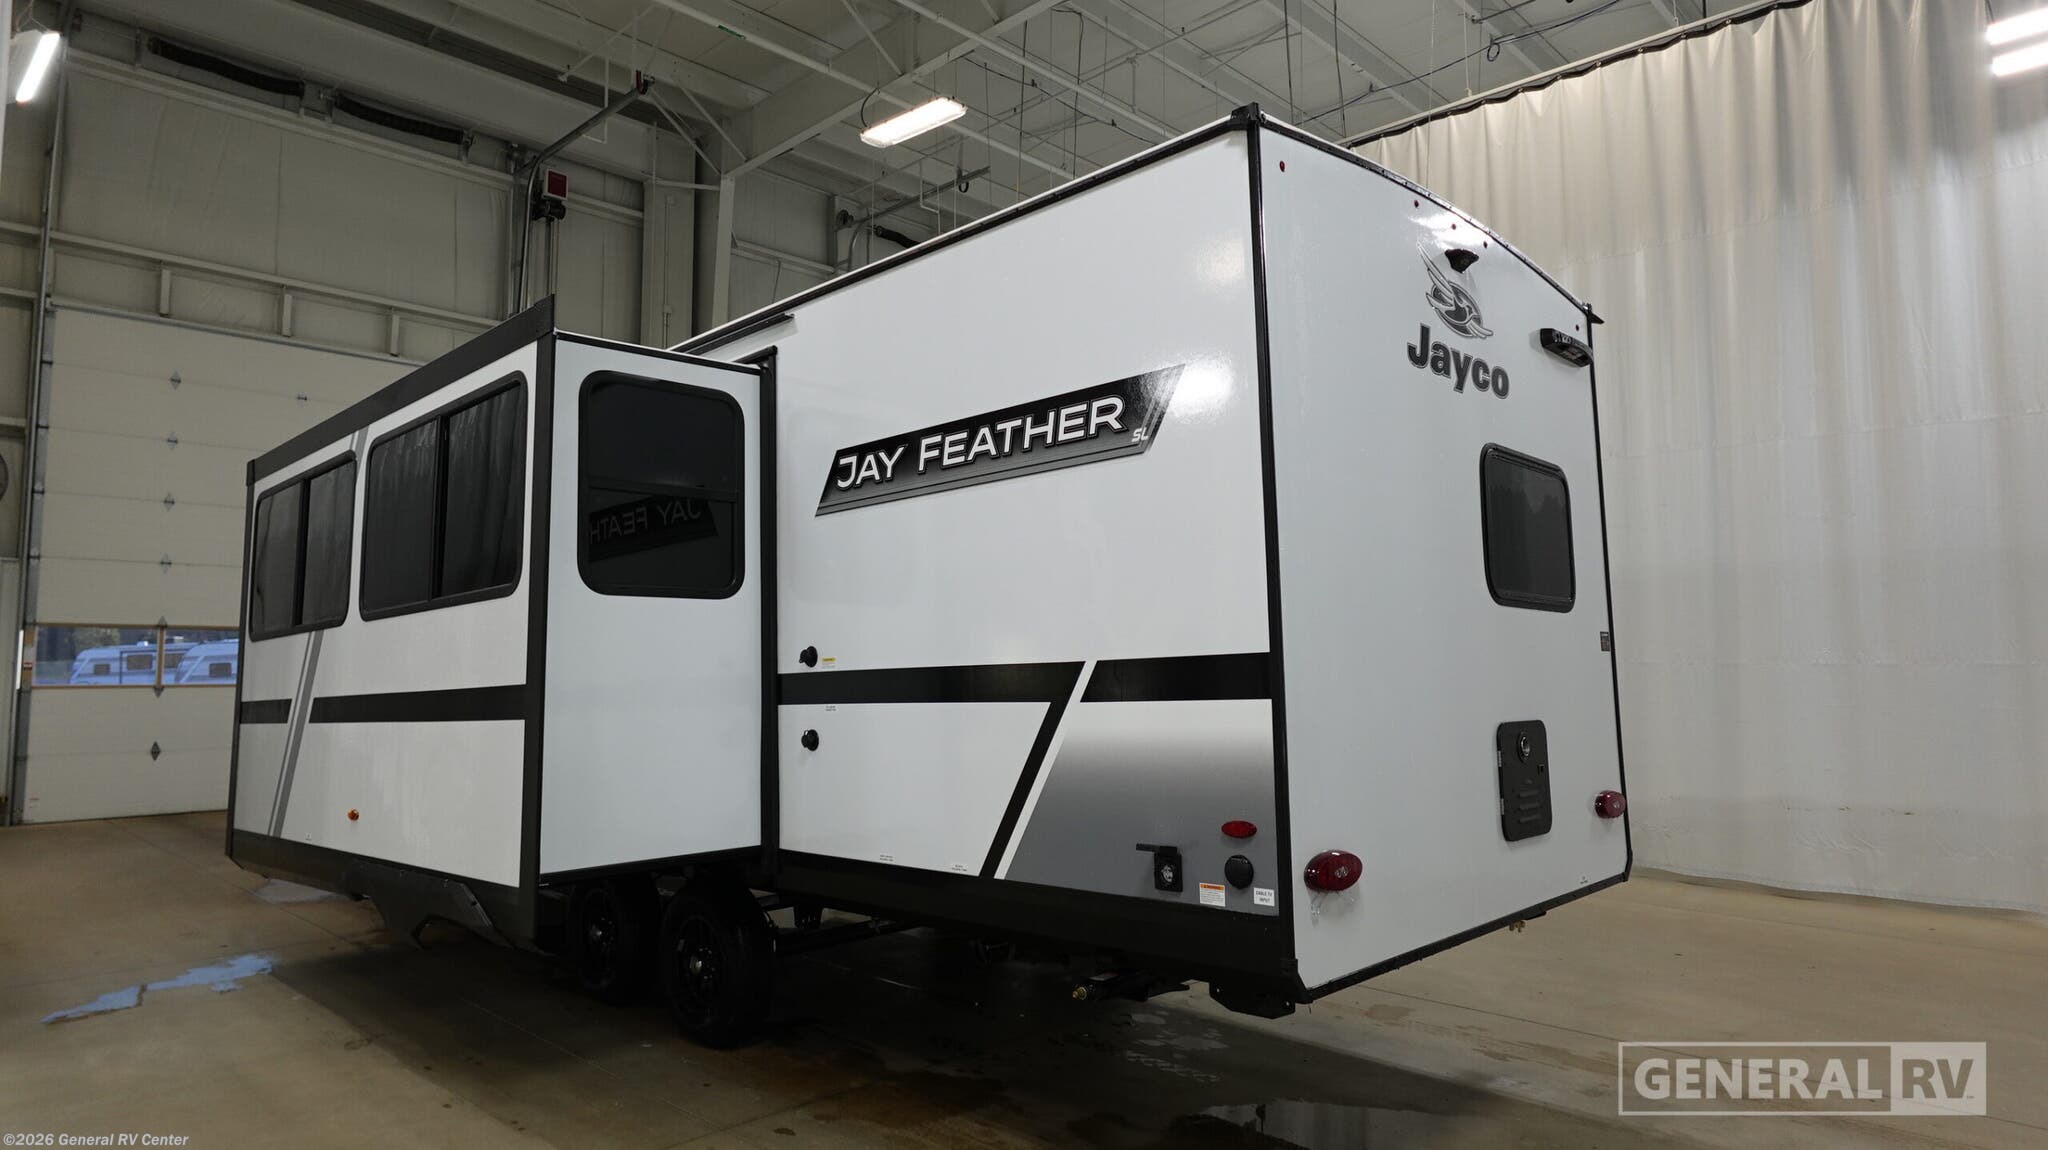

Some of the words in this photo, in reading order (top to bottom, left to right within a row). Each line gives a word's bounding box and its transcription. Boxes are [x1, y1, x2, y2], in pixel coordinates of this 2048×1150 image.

[1407, 323, 1510, 399] Jayco
[836, 447, 905, 489] JAY
[918, 395, 1125, 473] FEATHER
[1131, 427, 1149, 444] SL
